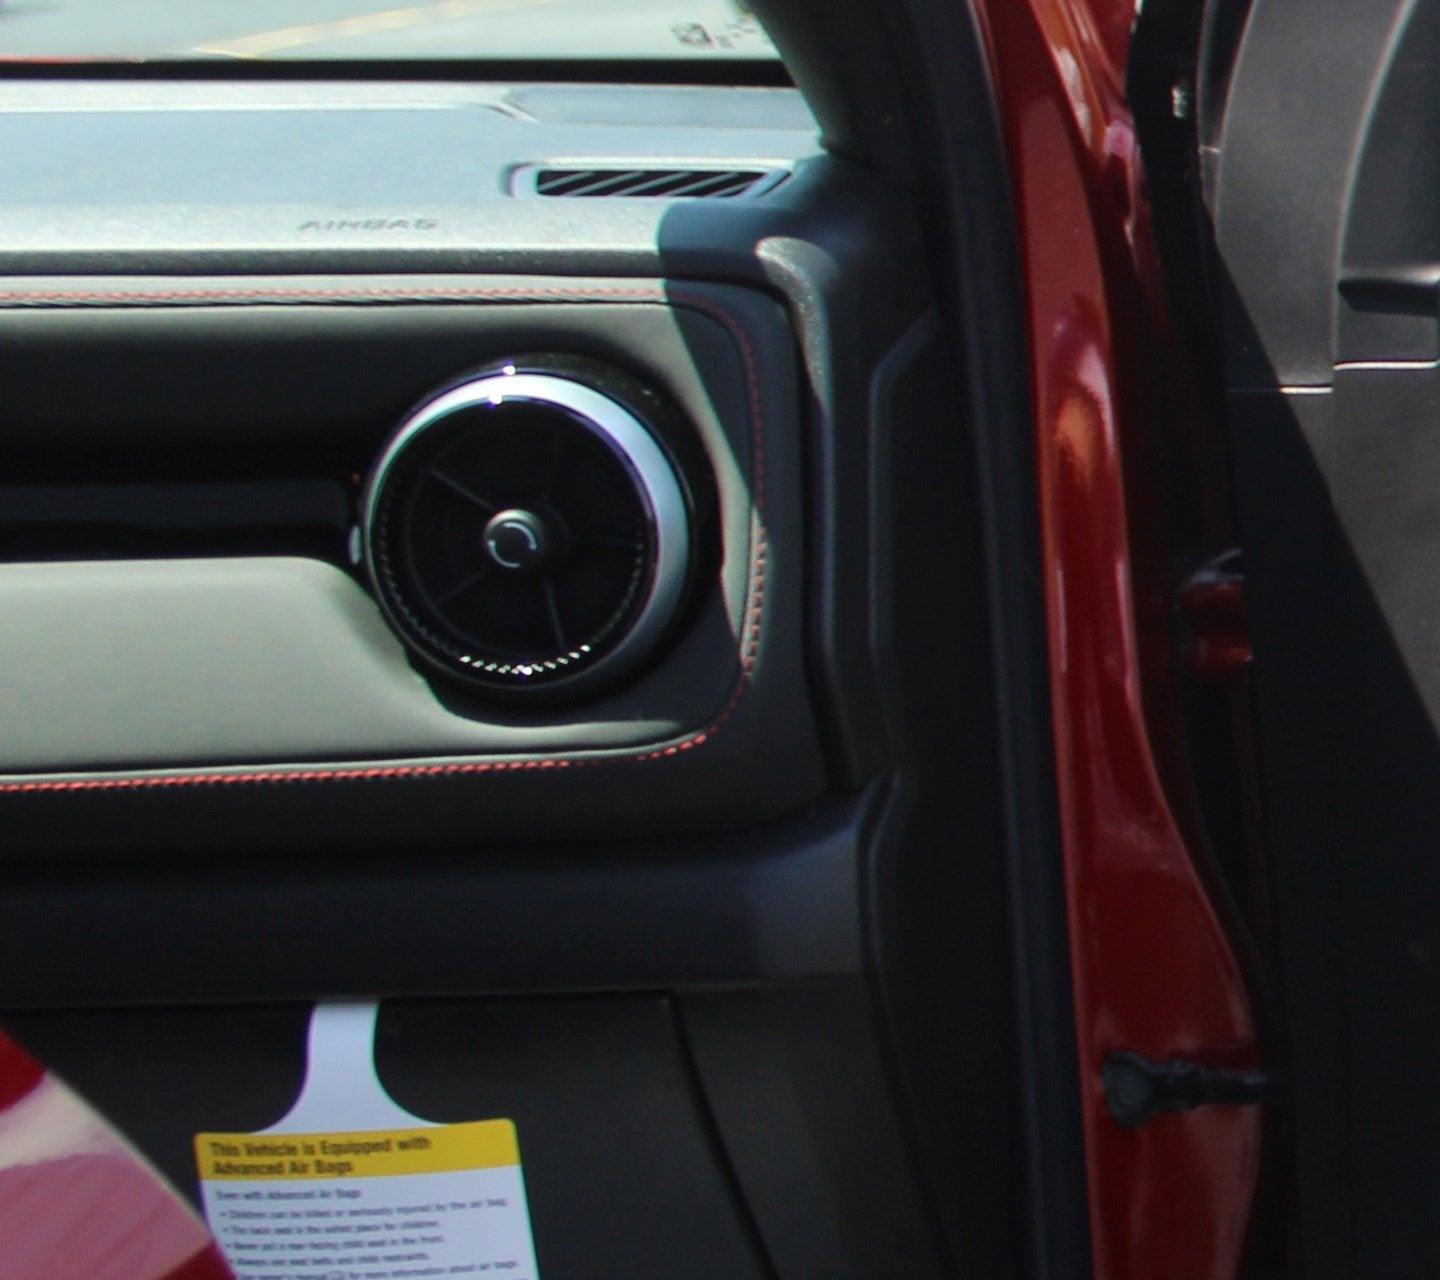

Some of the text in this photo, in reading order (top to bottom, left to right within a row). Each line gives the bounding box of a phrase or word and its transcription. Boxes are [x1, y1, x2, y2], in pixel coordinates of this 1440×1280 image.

[298, 217, 440, 231] AIRBAG
[210, 1141, 240, 1156] This
[243, 1141, 297, 1157] Vehicle
[320, 1139, 391, 1157] Equipped
[398, 1134, 432, 1150] with
[215, 1159, 352, 1177] Advanced Air Bags
